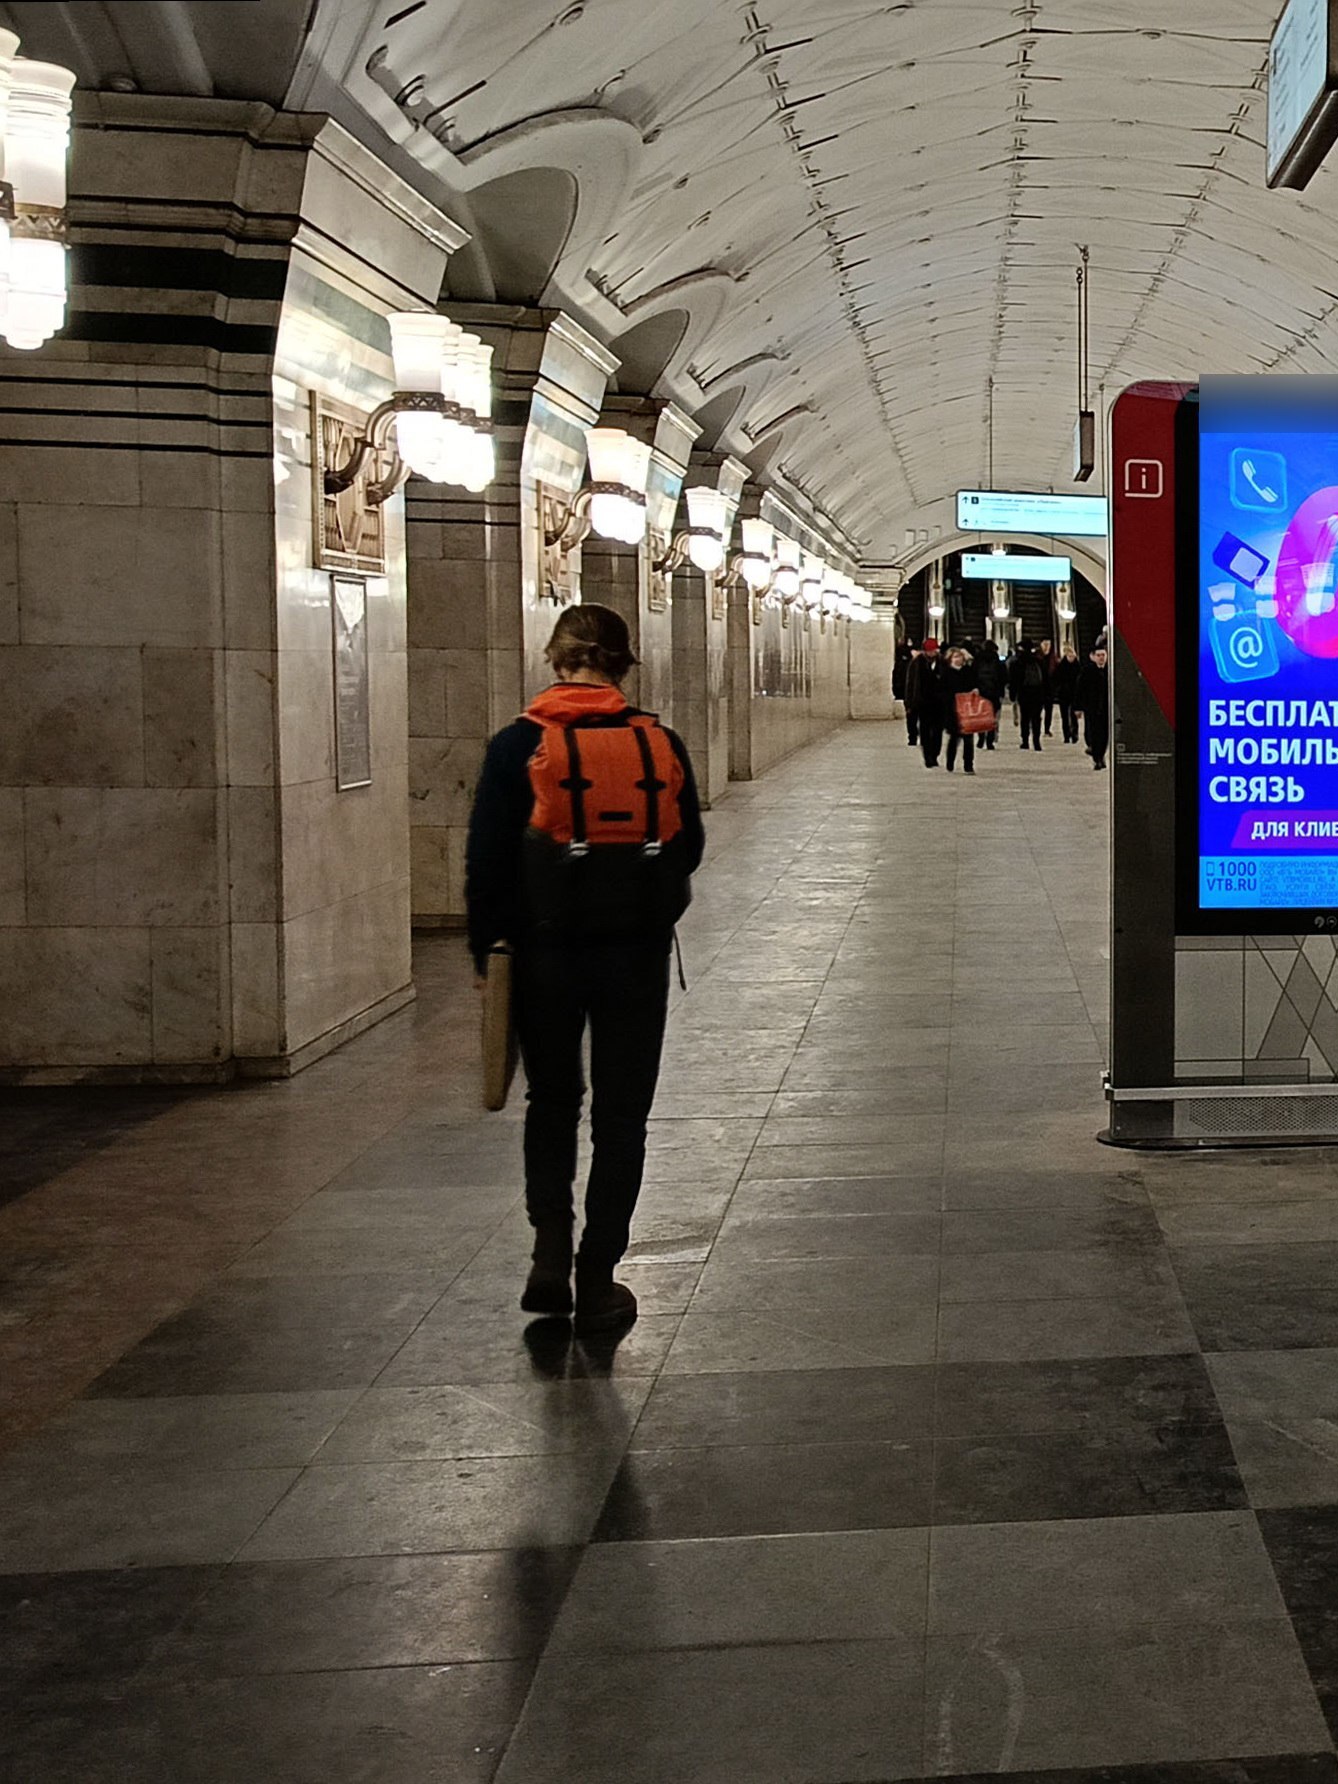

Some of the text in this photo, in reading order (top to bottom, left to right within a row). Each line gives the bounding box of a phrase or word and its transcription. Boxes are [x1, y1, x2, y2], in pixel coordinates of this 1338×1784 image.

[1209, 776, 1305, 803] СВЯЗЬ
[1251, 821, 1289, 840] ДЛЯ
[1219, 861, 1257, 876] 1000
[1206, 878, 1257, 891] VTB.RU
